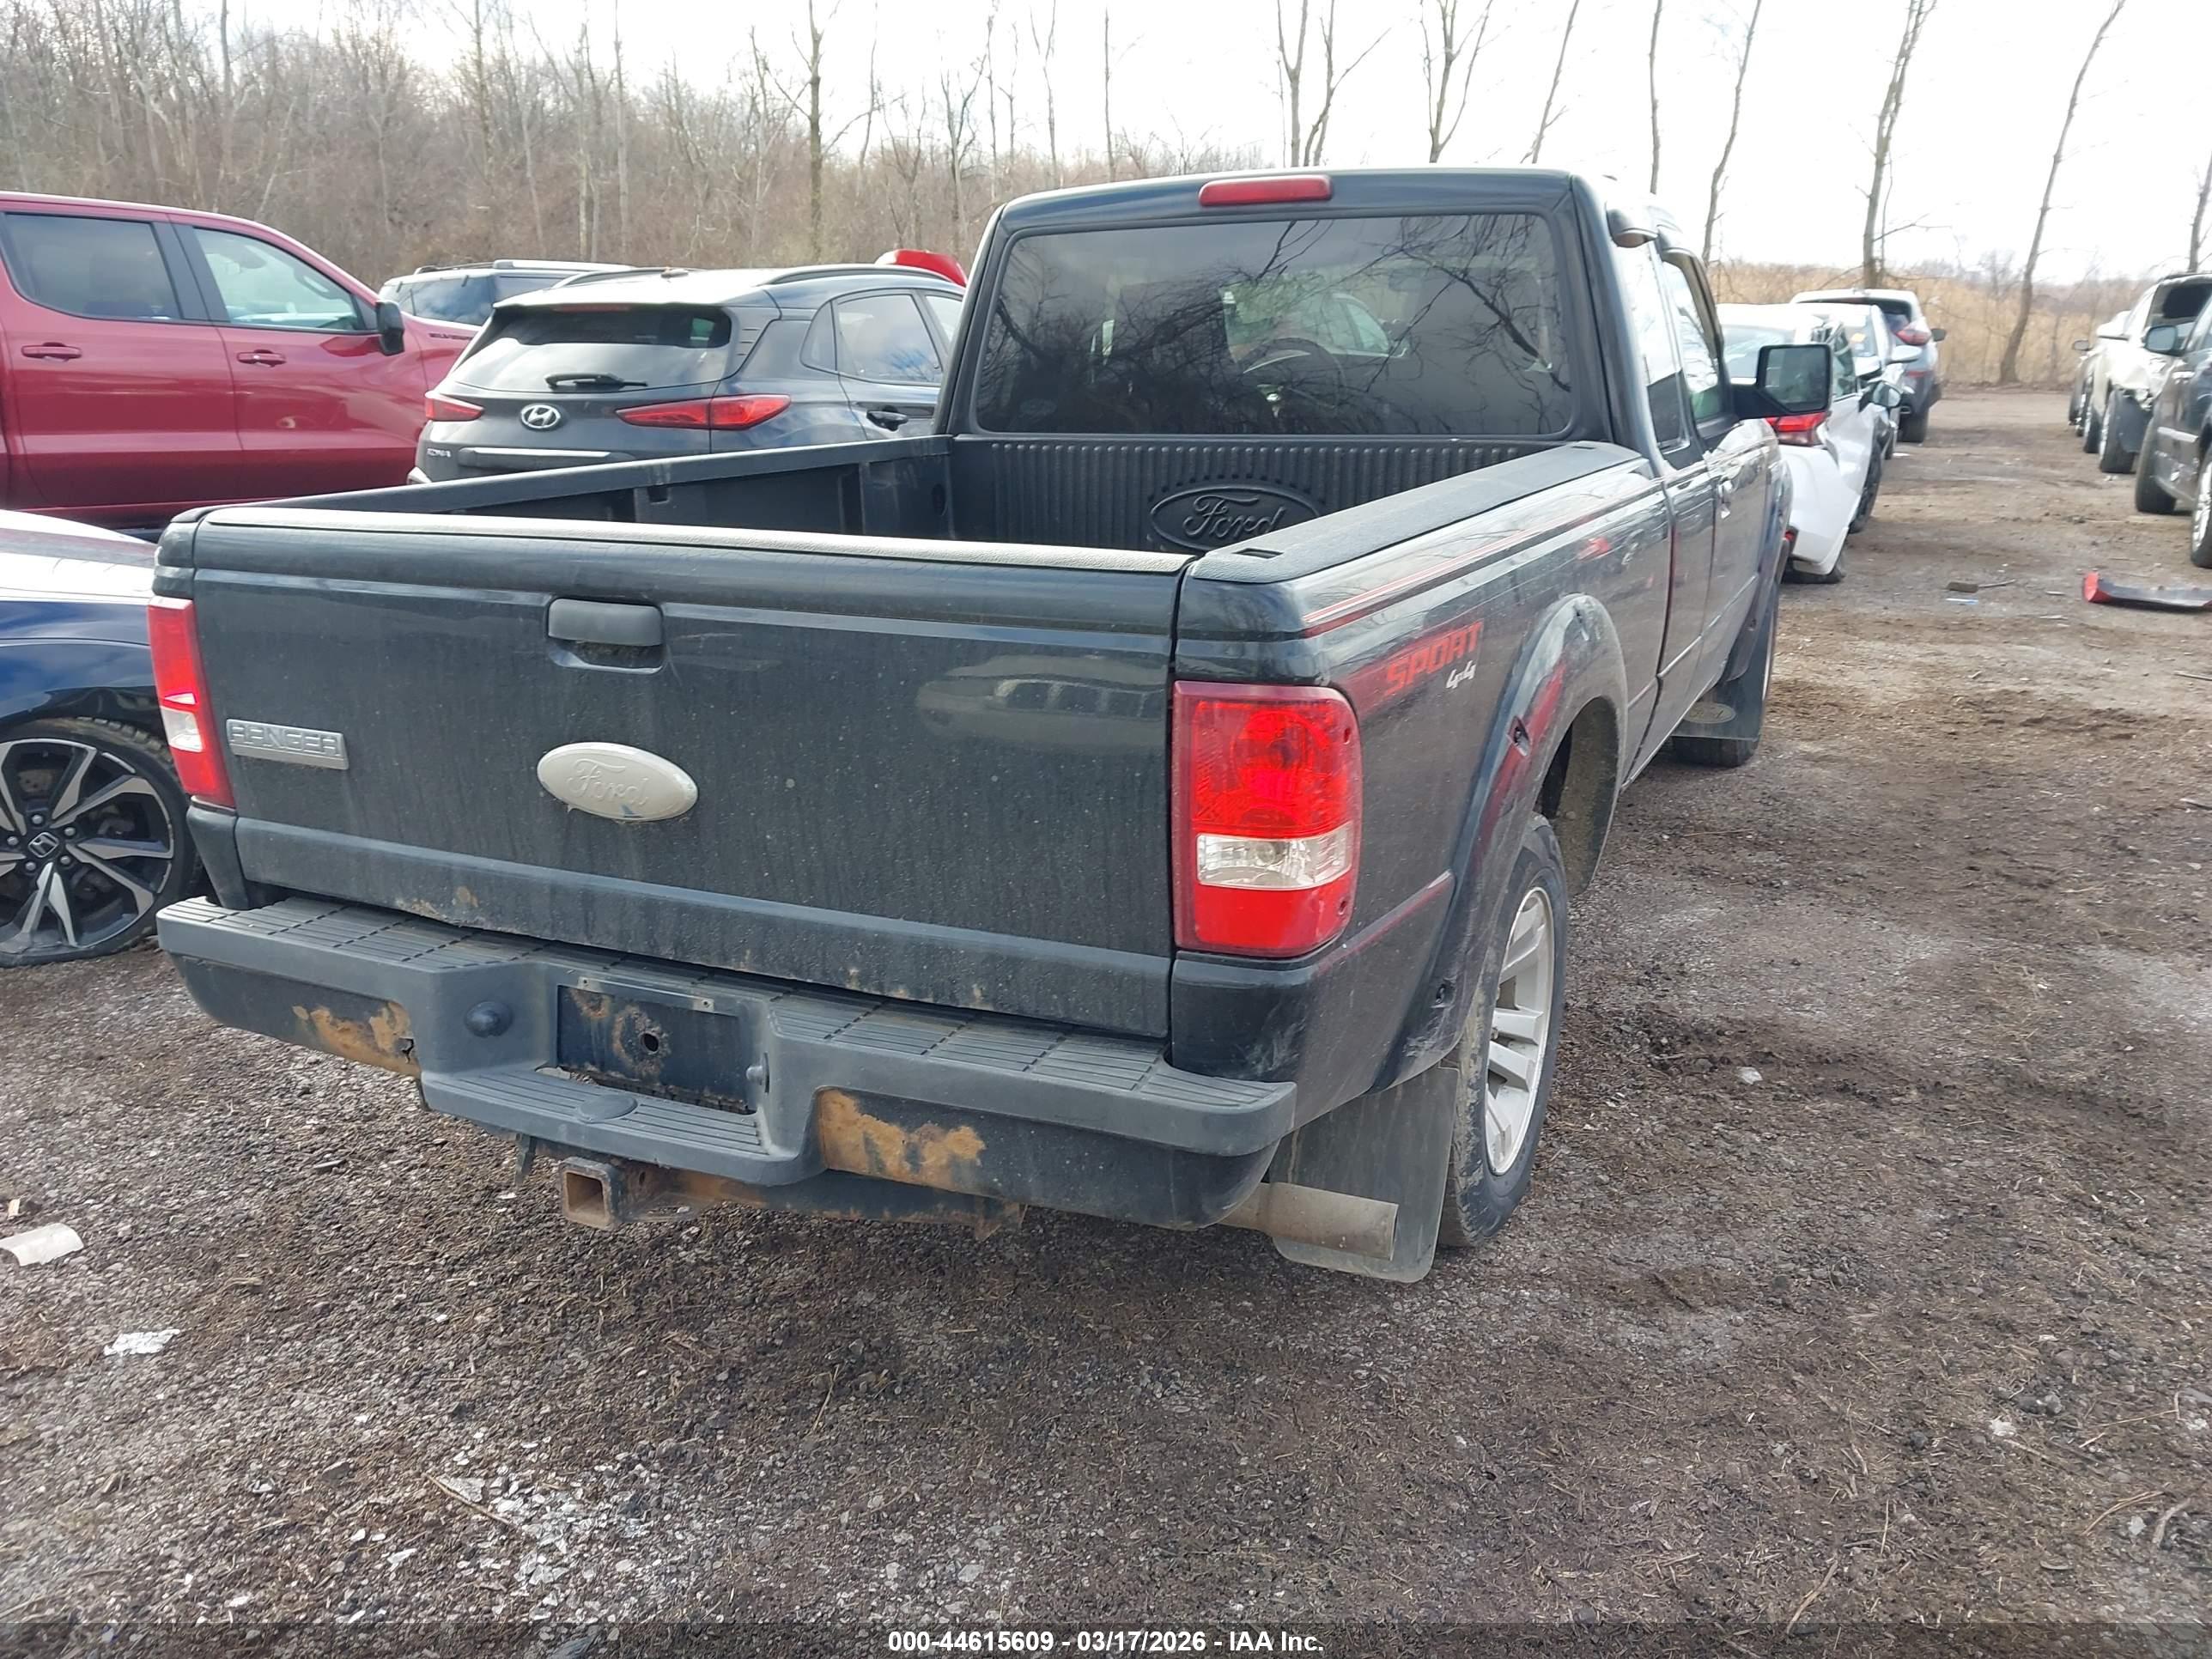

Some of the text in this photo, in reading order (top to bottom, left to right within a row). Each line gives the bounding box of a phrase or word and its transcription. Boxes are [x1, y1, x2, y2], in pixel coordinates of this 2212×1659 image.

[1182, 494, 1286, 538] Ford
[1384, 619, 1483, 696] SPORT
[228, 724, 343, 757] RANGER
[566, 757, 650, 805] Ford
